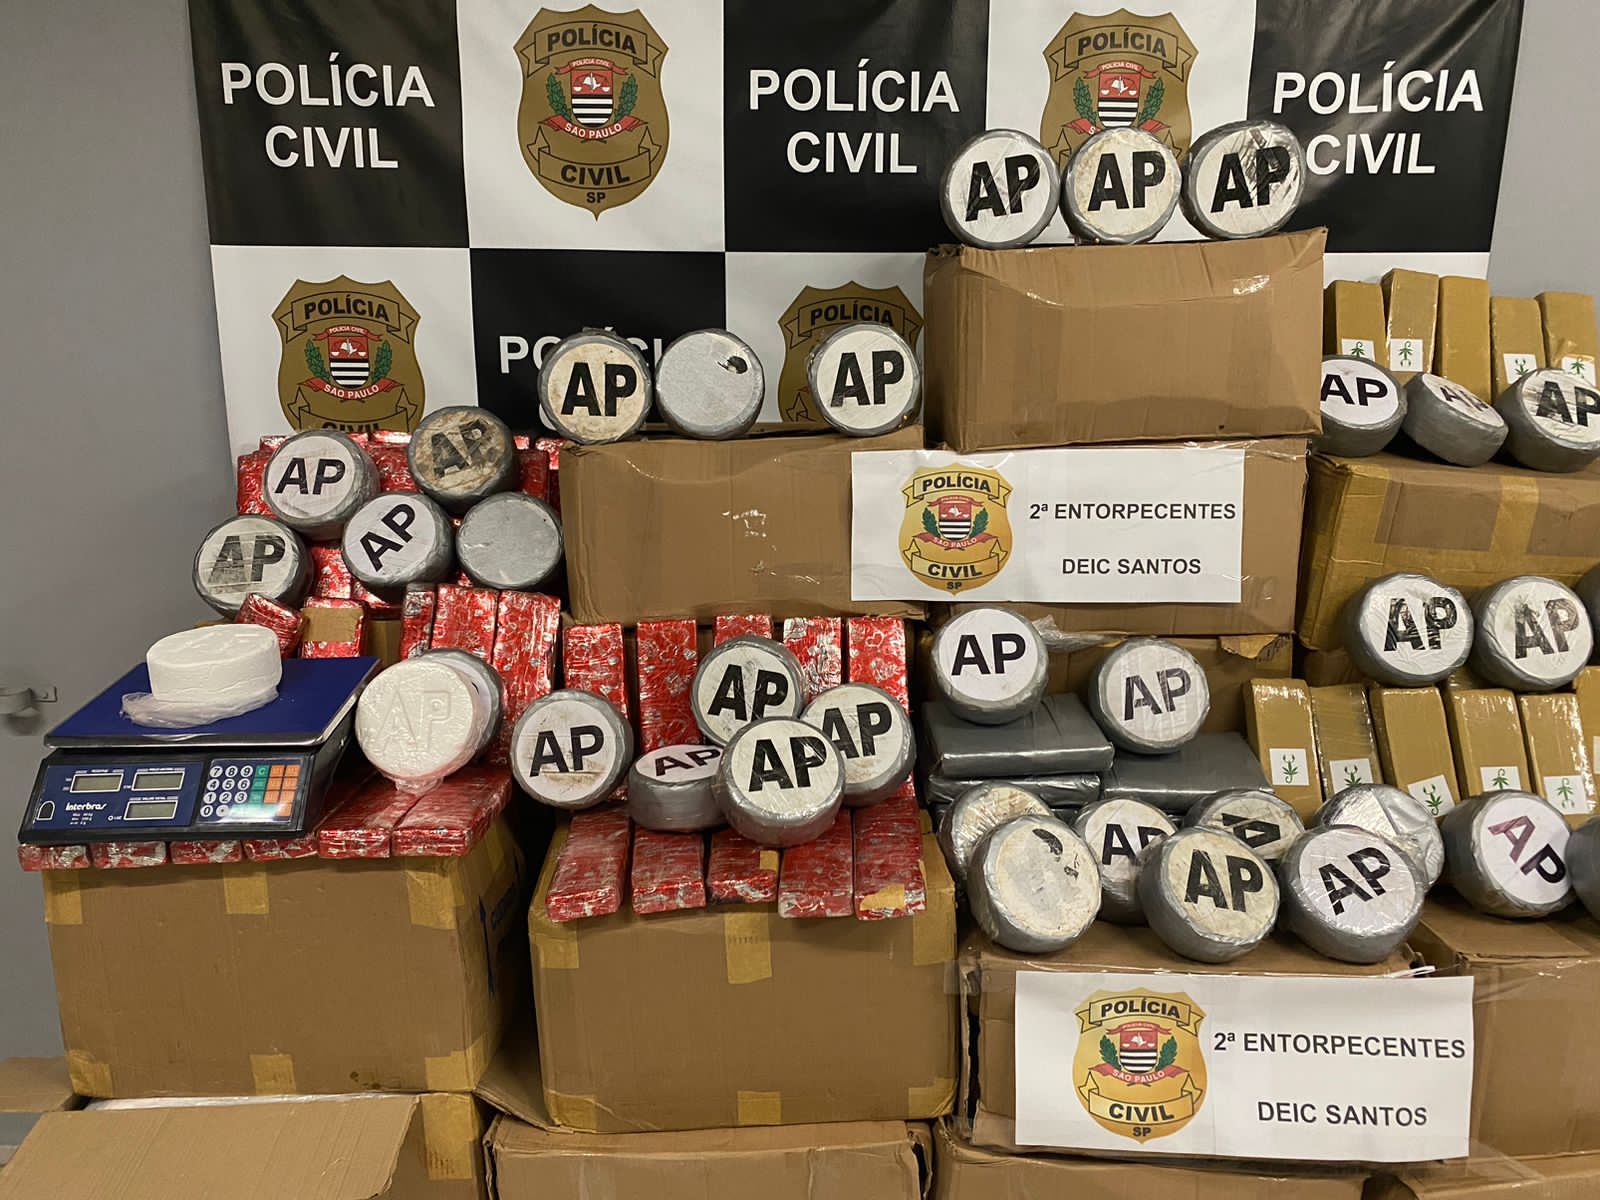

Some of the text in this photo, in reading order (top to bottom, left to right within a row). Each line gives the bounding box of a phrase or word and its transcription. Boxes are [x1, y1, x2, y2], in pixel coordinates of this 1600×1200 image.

[548, 24, 637, 54] POLÍCIA
[1078, 27, 1166, 58] POLÍCIA
[221, 53, 435, 108] POLÍCIA
[749, 59, 960, 113] POLÍCIA
[1272, 61, 1484, 115] POLÍCIA
[265, 126, 398, 168] CIVIL
[589, 123, 622, 139] PAULO
[786, 131, 918, 174] CIVIL
[560, 164, 630, 186] CIVIL
[1306, 132, 1436, 175] CIVIL
[586, 192, 606, 203] SP
[966, 154, 1040, 222] AP
[1087, 151, 1166, 212] AP
[1211, 146, 1291, 213] AP
[304, 295, 390, 322] POLÍCIA
[810, 301, 894, 327] POLÍCIA
[348, 385, 379, 399] PAULO
[561, 362, 637, 417] AP
[830, 350, 904, 407] AP
[1320, 374, 1388, 406] AP
[1536, 381, 1600, 427] AP
[275, 457, 346, 495] AP
[922, 473, 991, 492] POLÍCIA
[1029, 503, 1236, 520] 2ª ENTORPECENTES
[359, 503, 416, 571] AP
[208, 535, 285, 584] AP
[928, 564, 982, 578] CIVIL
[1062, 558, 1201, 575] DEIC SANTOS
[1383, 596, 1458, 652] AP
[1514, 598, 1580, 659] AP
[951, 633, 1026, 676] AP
[708, 664, 788, 722] AP
[1124, 668, 1191, 721] AP
[529, 724, 604, 777] AP
[822, 702, 892, 759] AP
[655, 750, 721, 776] AP
[749, 735, 826, 792] AP
[1487, 815, 1566, 884] AP
[1184, 849, 1264, 913] AP
[1318, 847, 1391, 916] AP
[1101, 997, 1180, 1018] POLÍCIA
[1213, 1032, 1466, 1059] 2ª ENTORPECENTES
[1135, 1071, 1165, 1083] PAULO
[1109, 1103, 1174, 1121] CIVIL
[1132, 1127, 1151, 1136] SP
[1257, 1101, 1428, 1126] DEIC SANTOS
